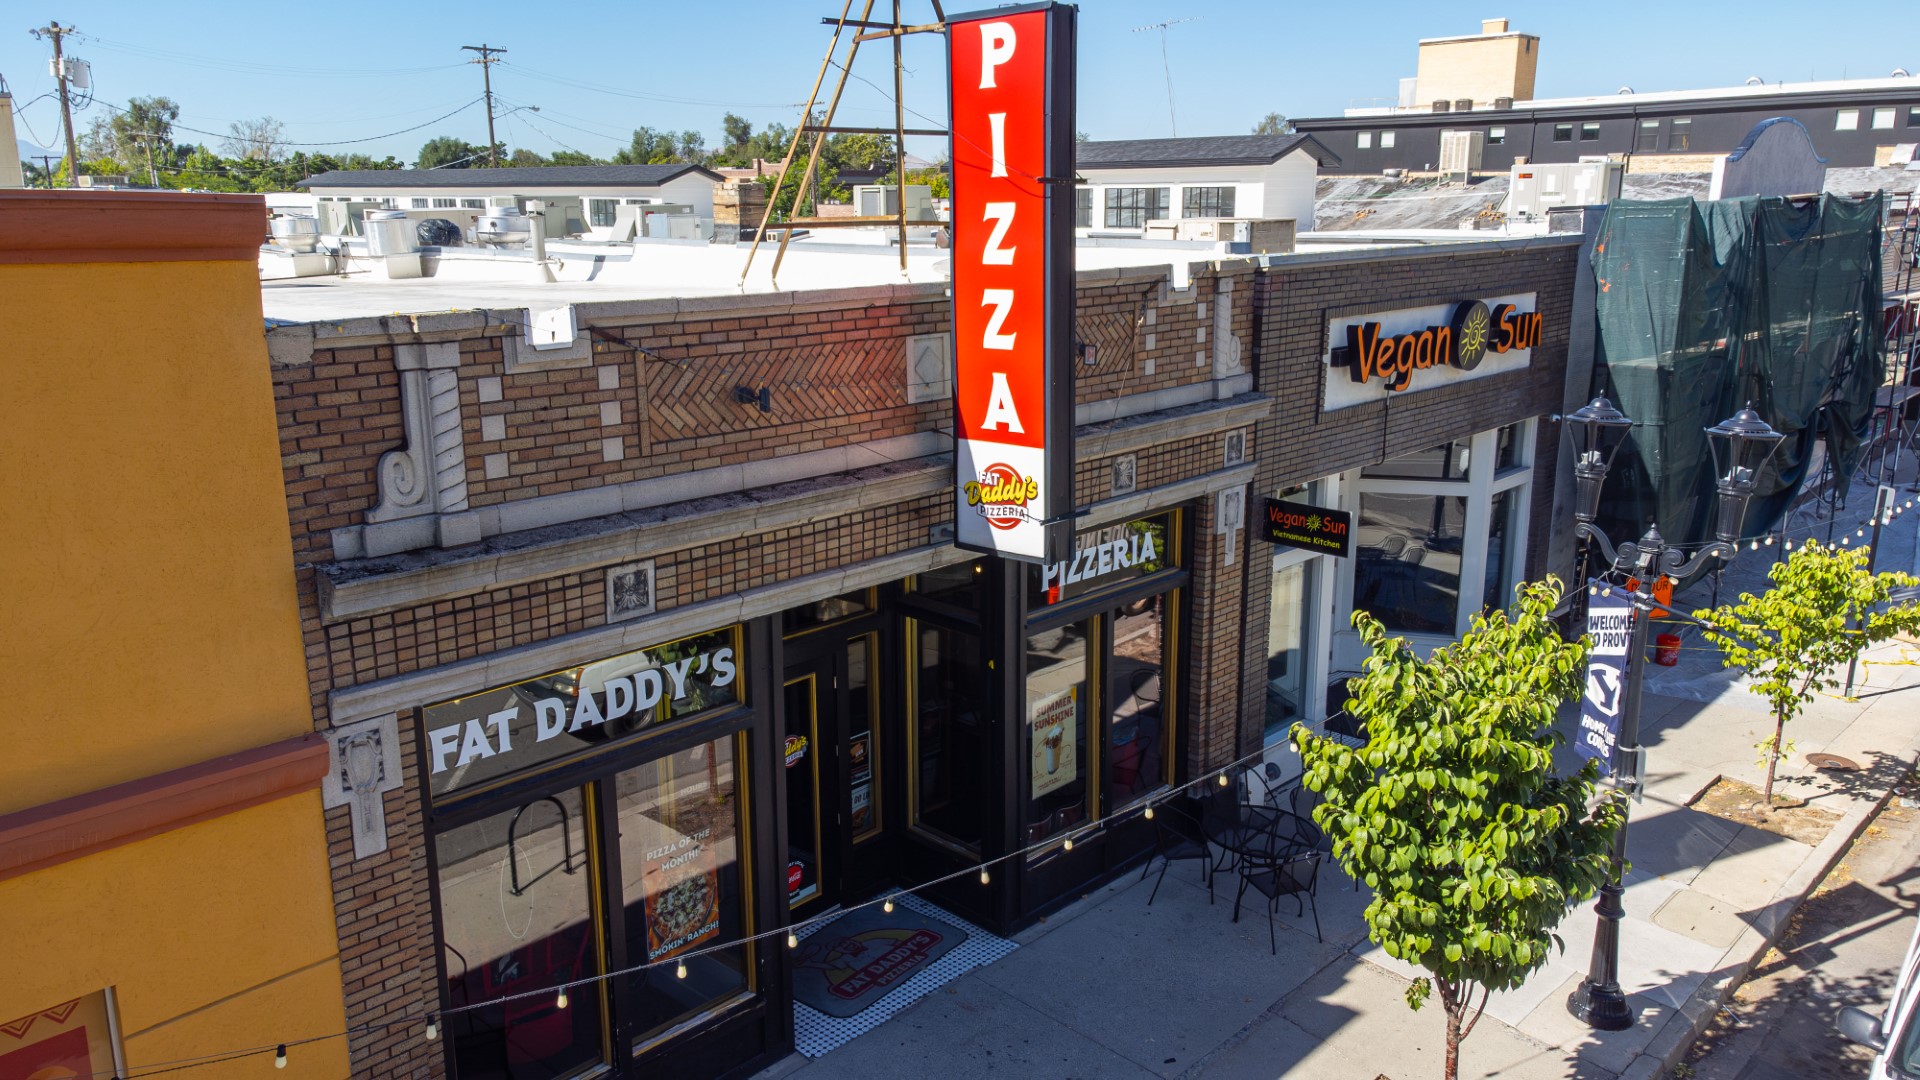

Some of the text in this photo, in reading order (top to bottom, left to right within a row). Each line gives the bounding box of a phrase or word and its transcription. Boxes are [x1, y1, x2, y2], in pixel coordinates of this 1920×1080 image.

[978, 22, 1025, 435] PIZZA
[1354, 304, 1543, 391] Vegan Sun
[964, 475, 1038, 506] Daddy's
[979, 471, 1000, 486] FAT
[980, 504, 1026, 518] PIZZERIA
[1269, 506, 1346, 535] Vegan Sun
[1273, 529, 1341, 549] Vietnamese Kitchen
[1041, 531, 1157, 593] PIZZERIA
[1589, 615, 1634, 631] WELCOME
[1603, 632, 1631, 648] PROV
[427, 647, 736, 775] FAT DADDY'S
[1034, 707, 1075, 731] SUNSHINE
[1036, 695, 1073, 718] SUMMER
[646, 828, 711, 862] PIZZA OF THE
[649, 920, 719, 961] SMOKIN' RANCH!
[839, 934, 931, 994] FAT DADDY'S
[879, 954, 926, 985] PIZZERIA
